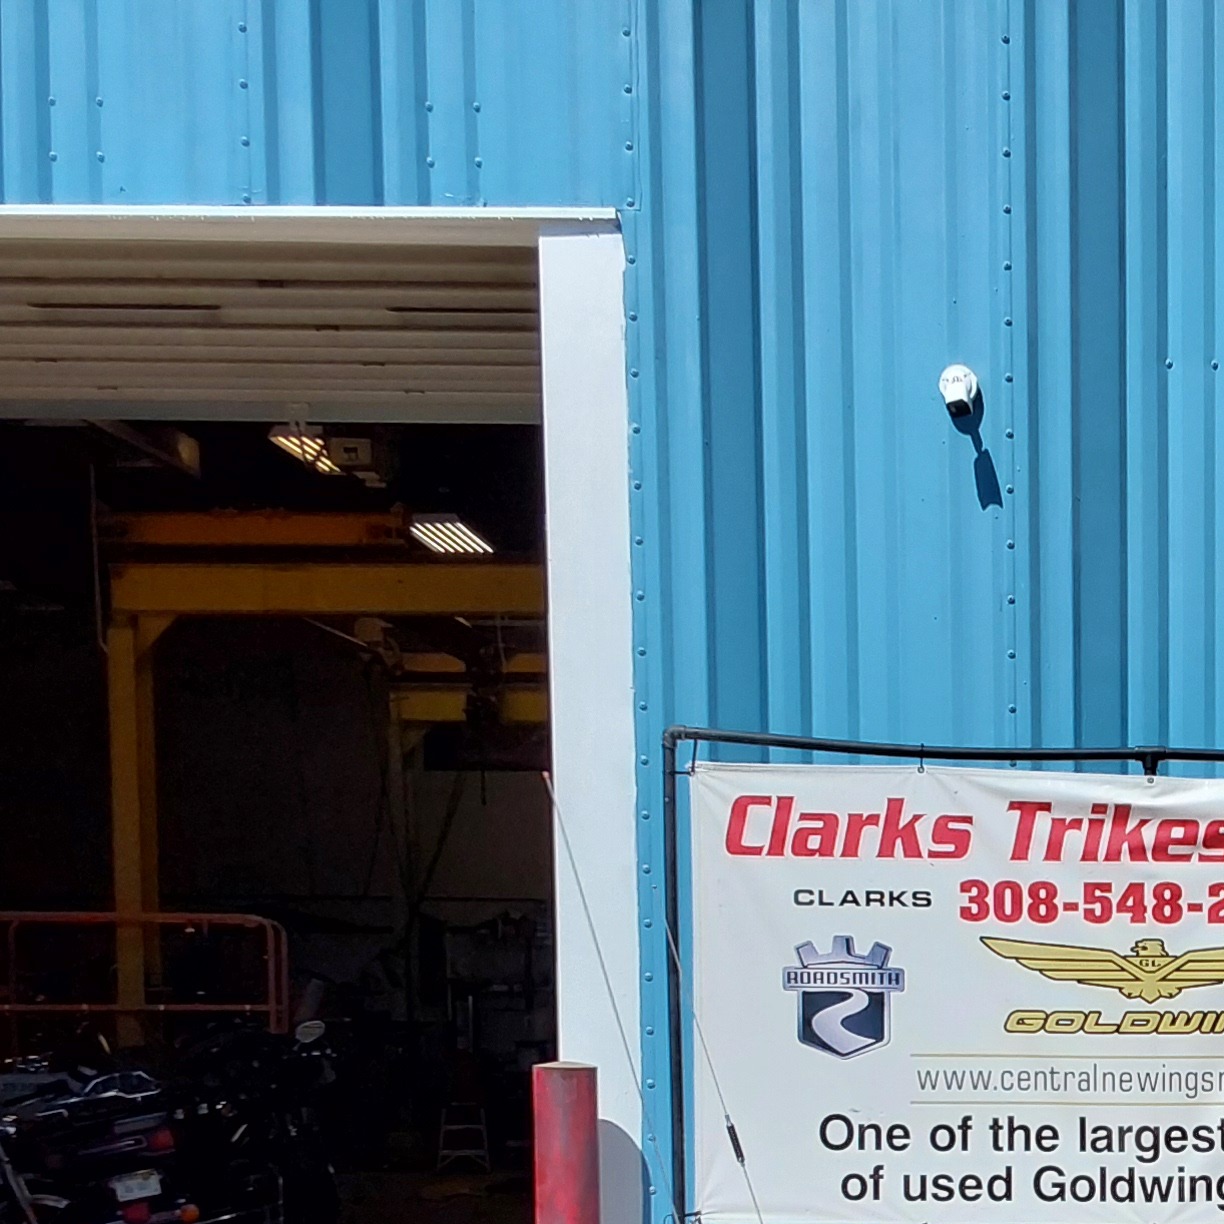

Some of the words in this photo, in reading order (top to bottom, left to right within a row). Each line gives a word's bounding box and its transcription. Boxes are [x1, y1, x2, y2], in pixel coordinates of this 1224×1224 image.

[725, 795, 974, 860] Clarks
[793, 888, 933, 908] CLARKS
[786, 971, 900, 985] ROADSMITH
[819, 1113, 911, 1153] One
[929, 1115, 973, 1153] of
[991, 1115, 1060, 1152] the
[840, 1165, 885, 1202] of
[903, 1165, 1013, 1203] used
